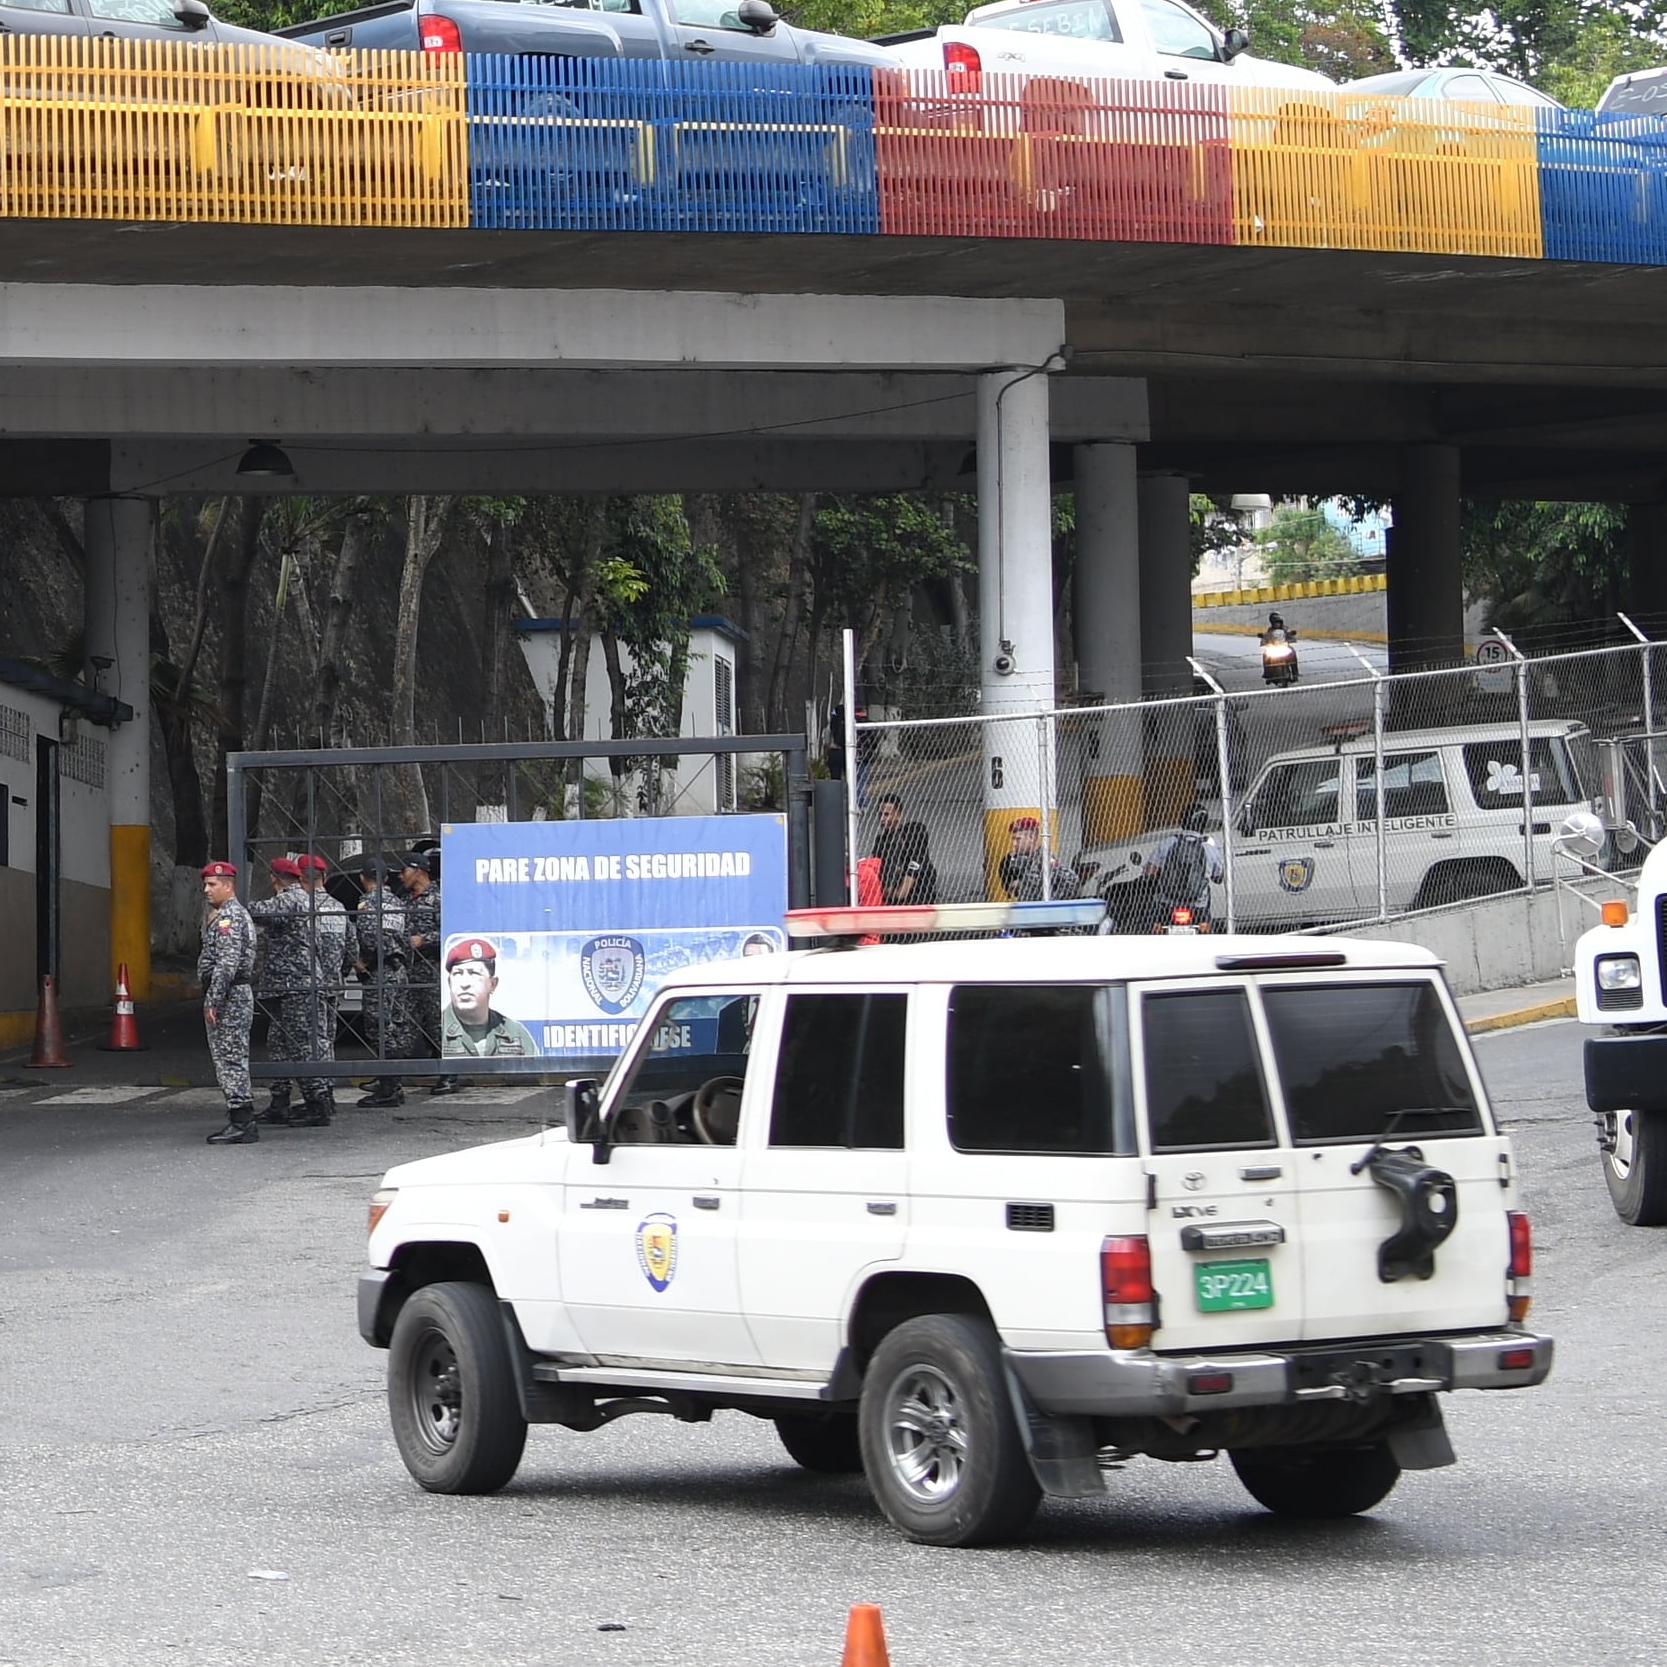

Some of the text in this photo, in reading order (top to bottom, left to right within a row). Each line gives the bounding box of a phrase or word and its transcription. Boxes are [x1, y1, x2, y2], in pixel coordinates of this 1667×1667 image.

[1485, 647, 1500, 659] 15
[991, 756, 1004, 789] 6
[1258, 815, 1456, 842] PATRULLAJE INTELIGENTE
[475, 852, 751, 883] PARE ZONA DE SEGURIDAD
[582, 956, 604, 1005] NACIONAL
[1199, 1272, 1269, 1299] 3P224
